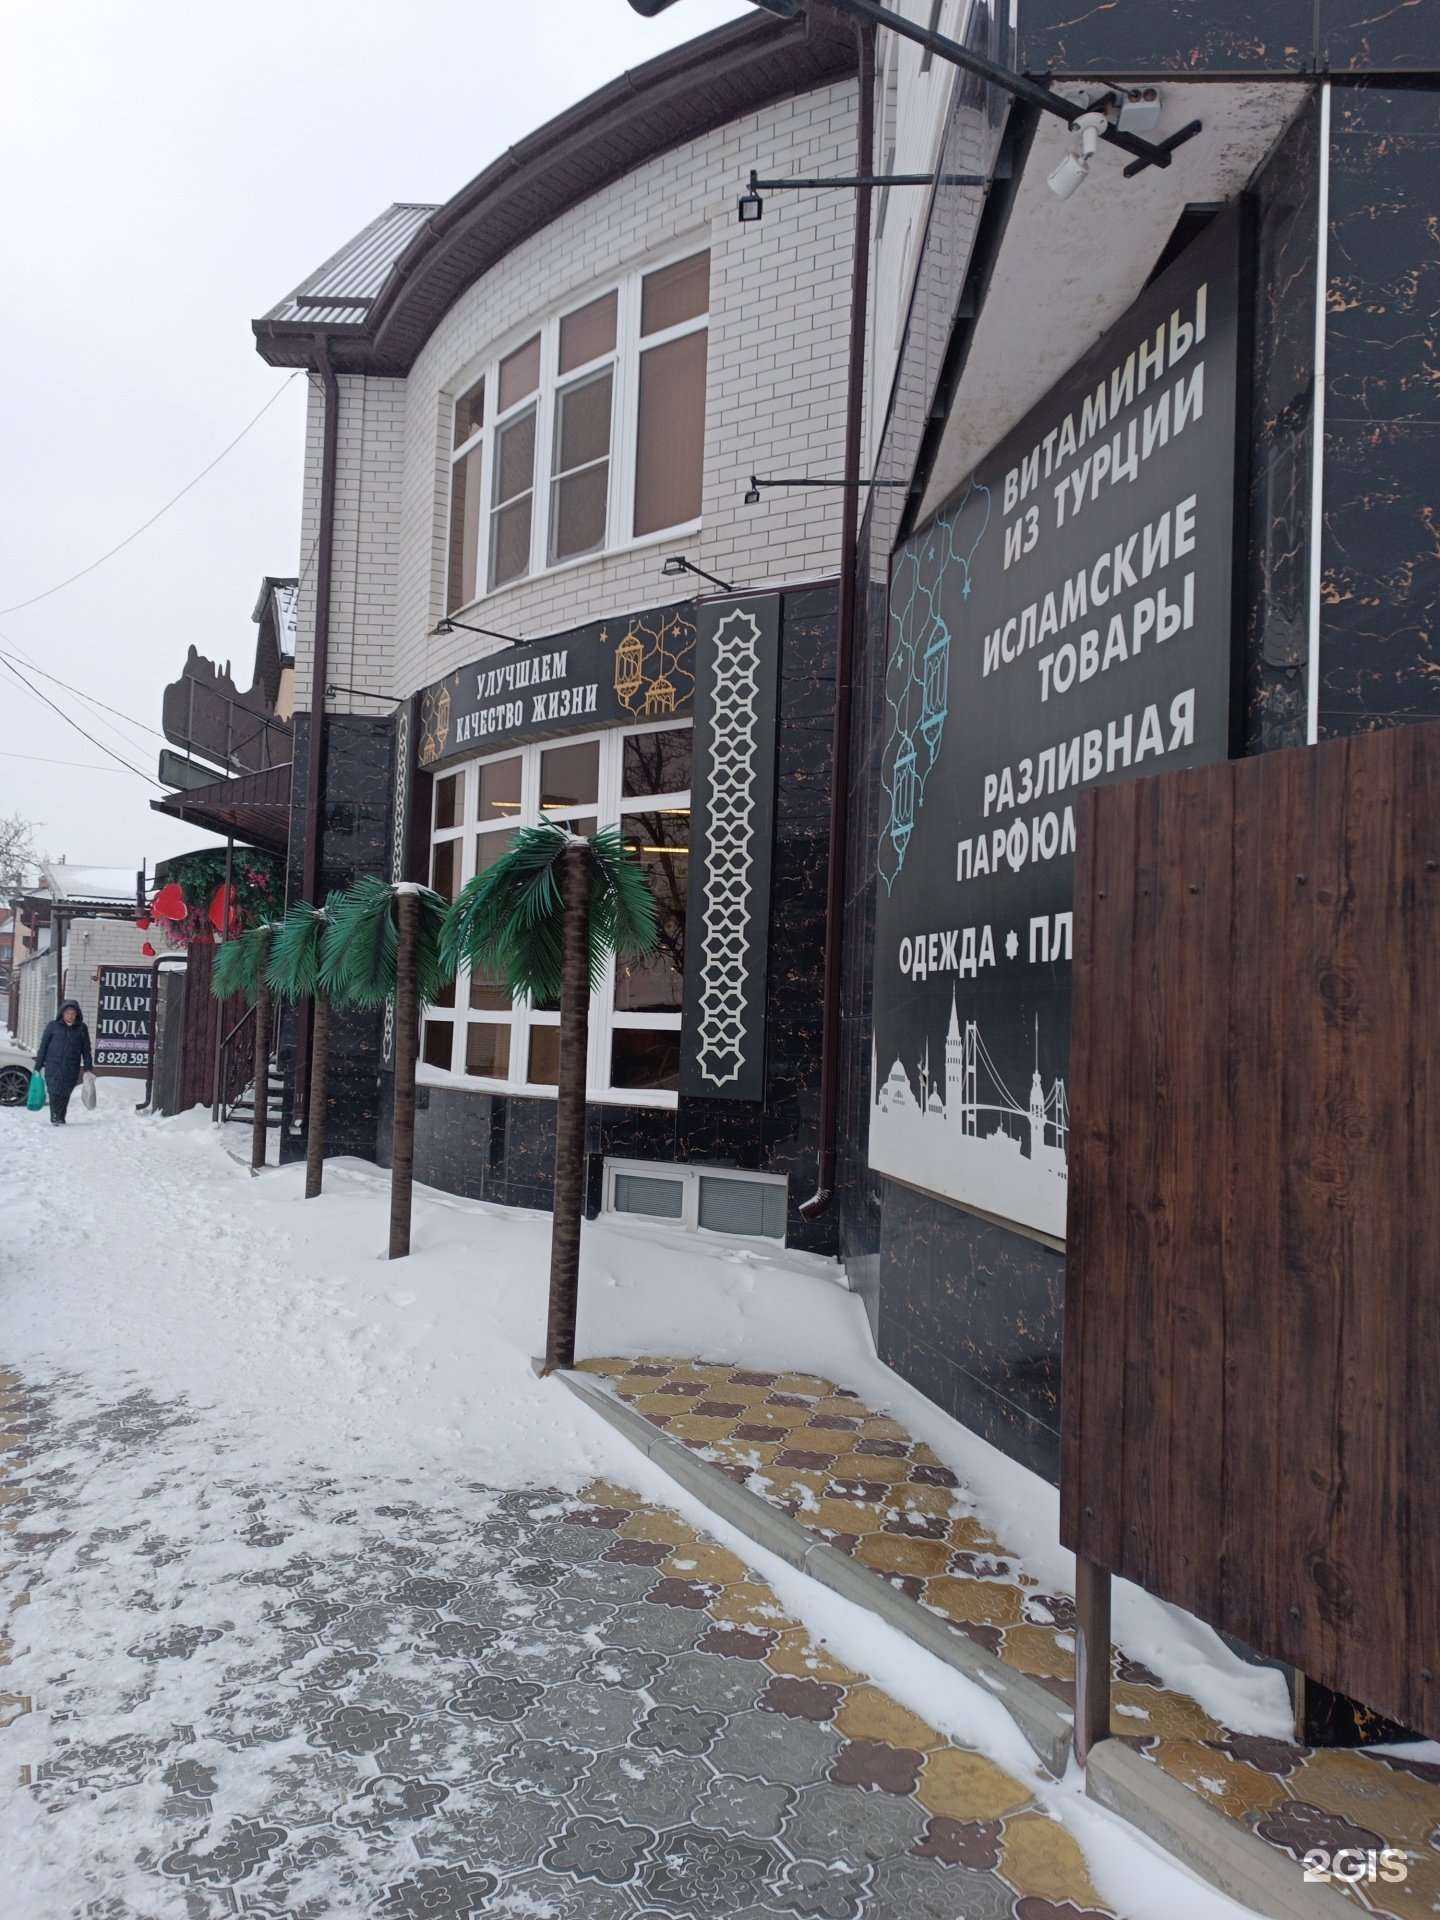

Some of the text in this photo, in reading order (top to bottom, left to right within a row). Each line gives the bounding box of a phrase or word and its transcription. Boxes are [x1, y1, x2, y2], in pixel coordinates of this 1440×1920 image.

[1003, 283, 1208, 516] ВИТАМИНЫ
[1003, 361, 1205, 570] ИЗ ТУРЦИИ
[982, 494, 1197, 678] ИСЛАМСКИЕ
[1038, 572, 1195, 702] ТОВАРЫ
[455, 684, 599, 743] КАЧЕСТВО ЖИЗНИ
[476, 650, 568, 700] УЛУЧШАЕМ
[983, 688, 1195, 817] РАЗЛИВНАЯ
[899, 925, 996, 981] ОДЕЖДА
[107, 1052, 128, 1064] 928
